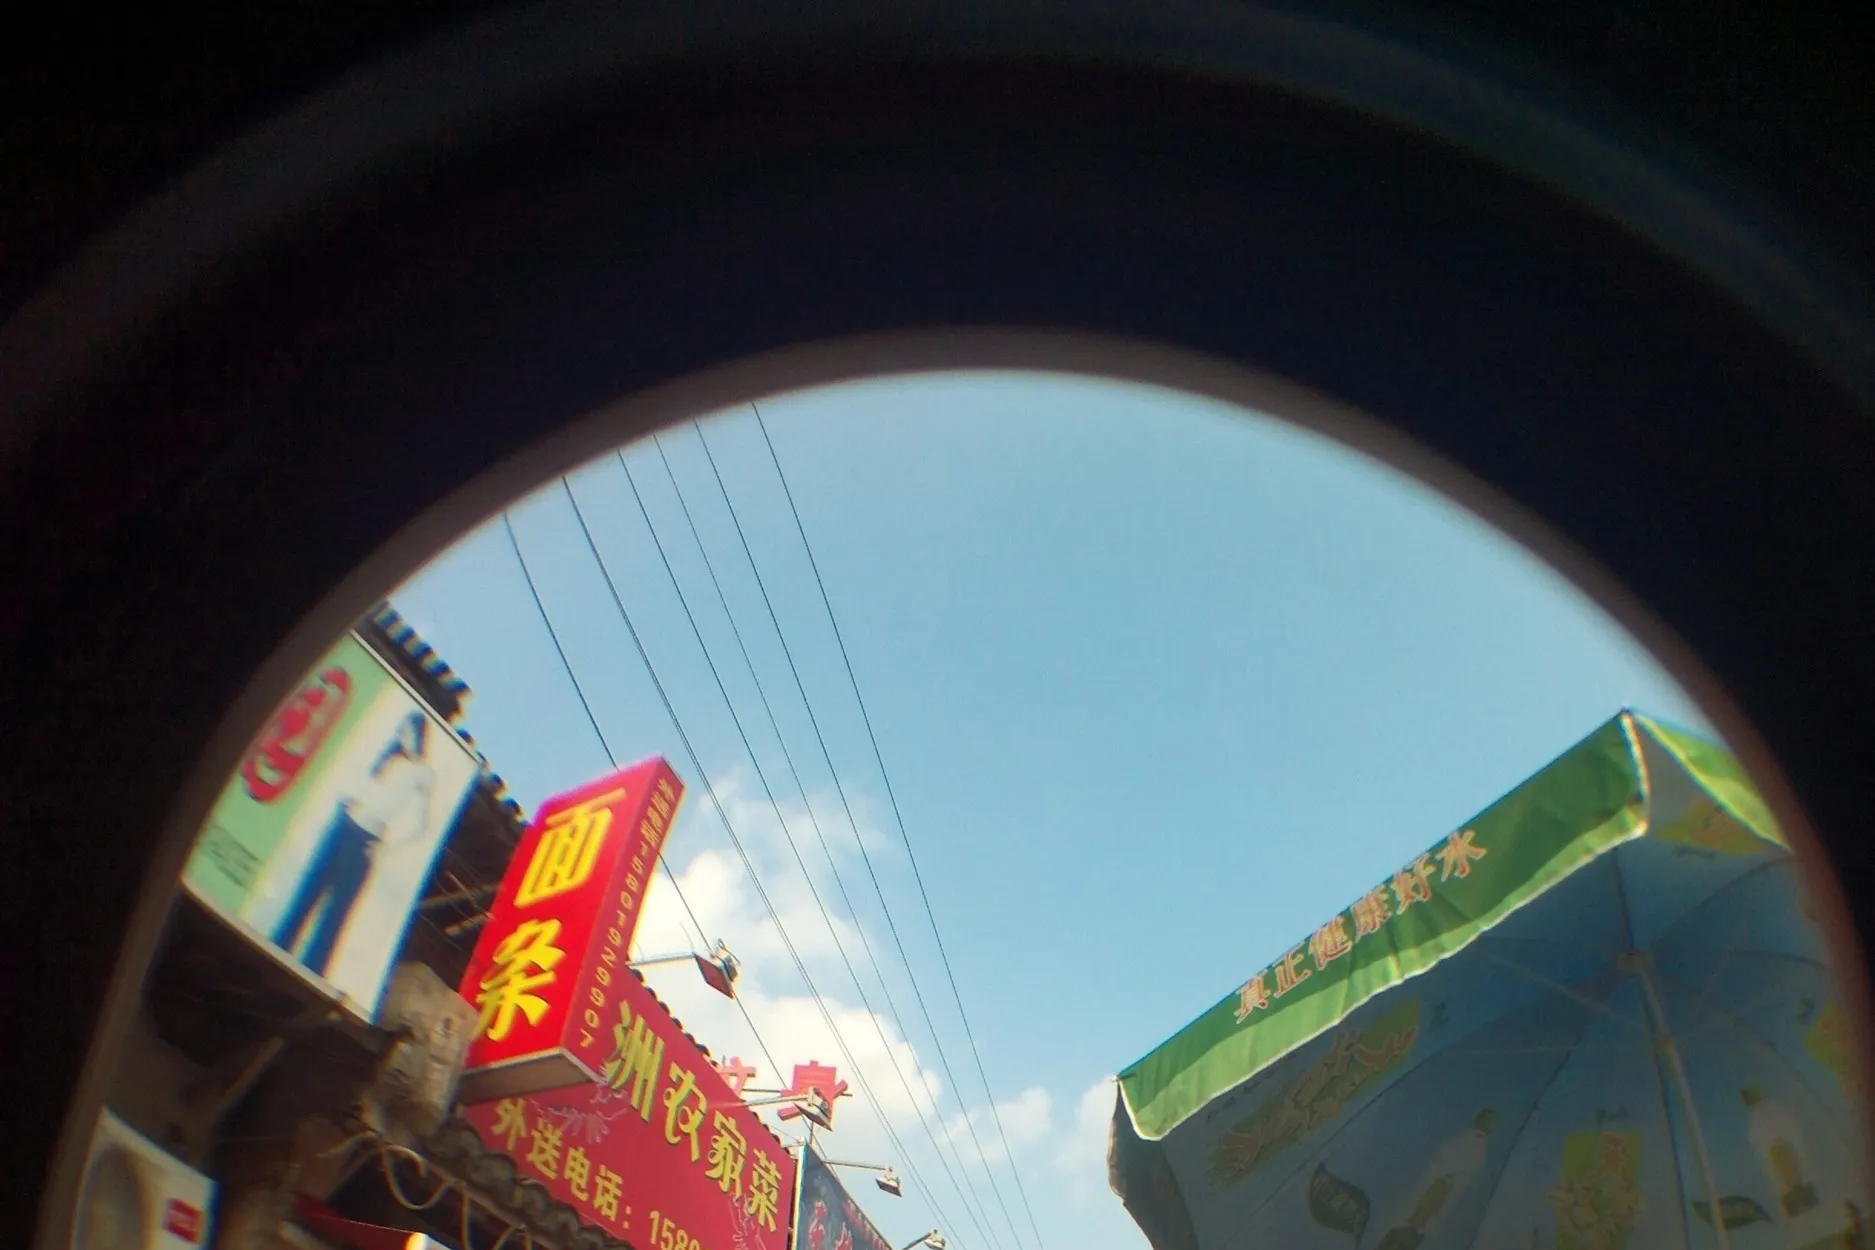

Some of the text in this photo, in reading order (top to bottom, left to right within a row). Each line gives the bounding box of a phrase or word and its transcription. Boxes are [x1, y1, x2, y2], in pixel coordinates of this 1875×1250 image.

[473, 786, 627, 1043] 面条
[1234, 829, 1488, 1025] 真正健康好水
